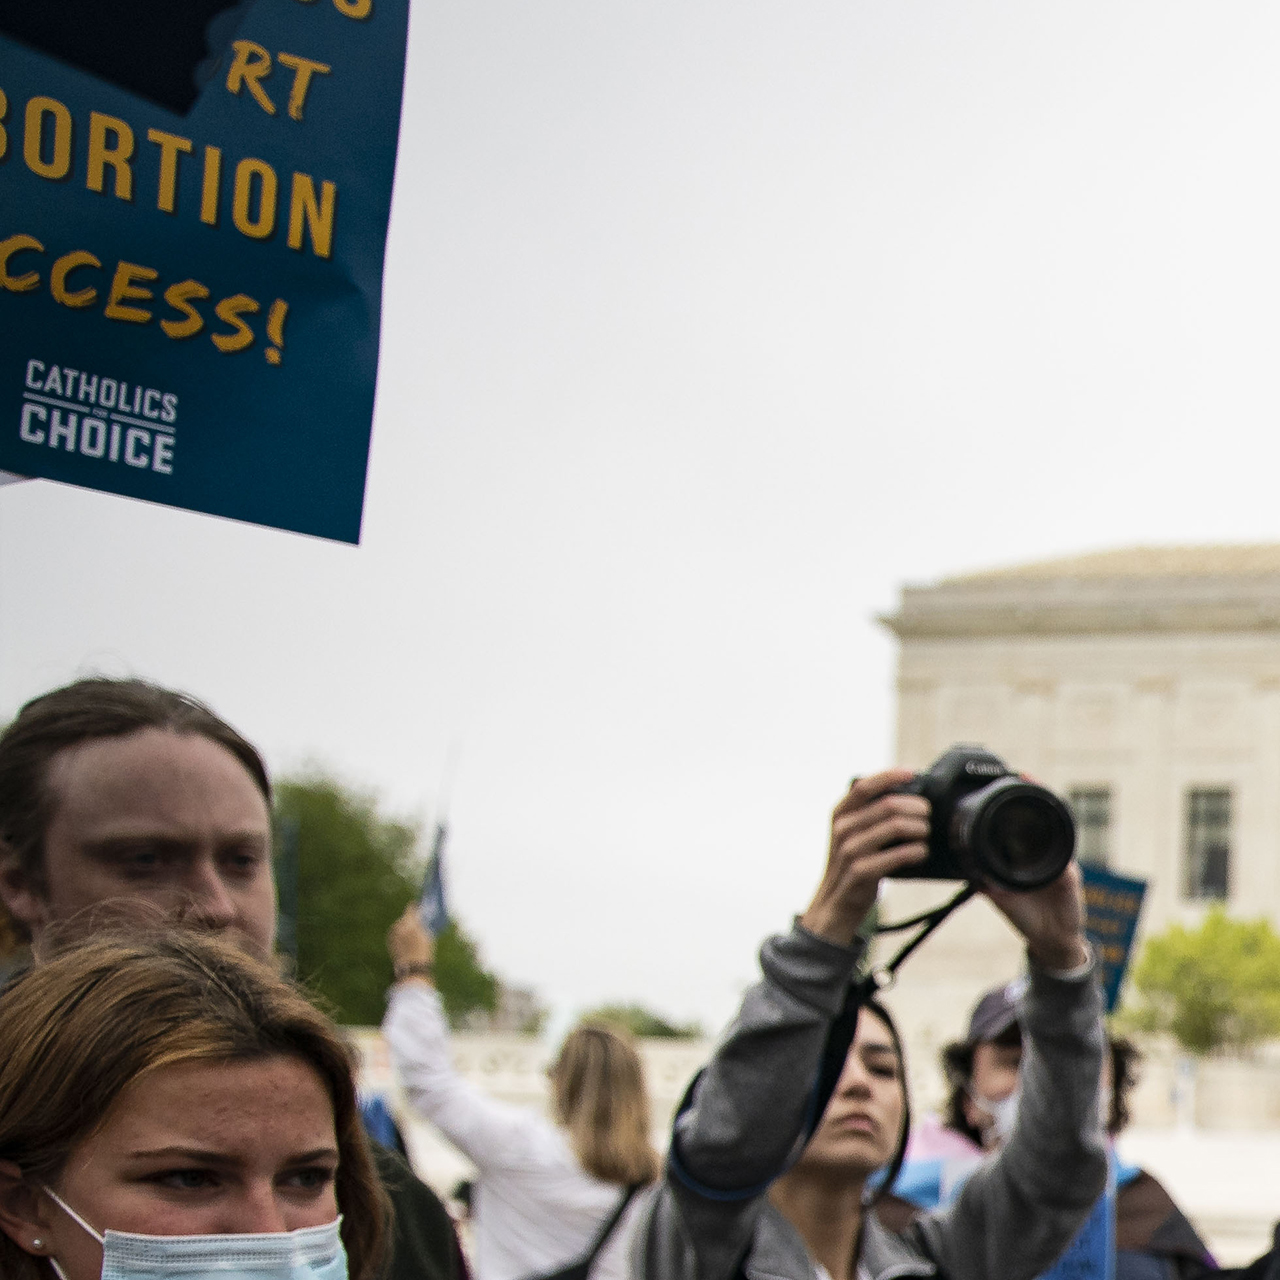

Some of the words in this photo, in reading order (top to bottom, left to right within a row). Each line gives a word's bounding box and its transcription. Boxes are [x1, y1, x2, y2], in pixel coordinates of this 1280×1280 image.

[226, 39, 331, 120] RT
[0, 86, 336, 259] ORTION
[0, 233, 287, 366] CCESS!
[25, 358, 179, 424] CATHOLICS
[19, 402, 176, 475] CHOICE
